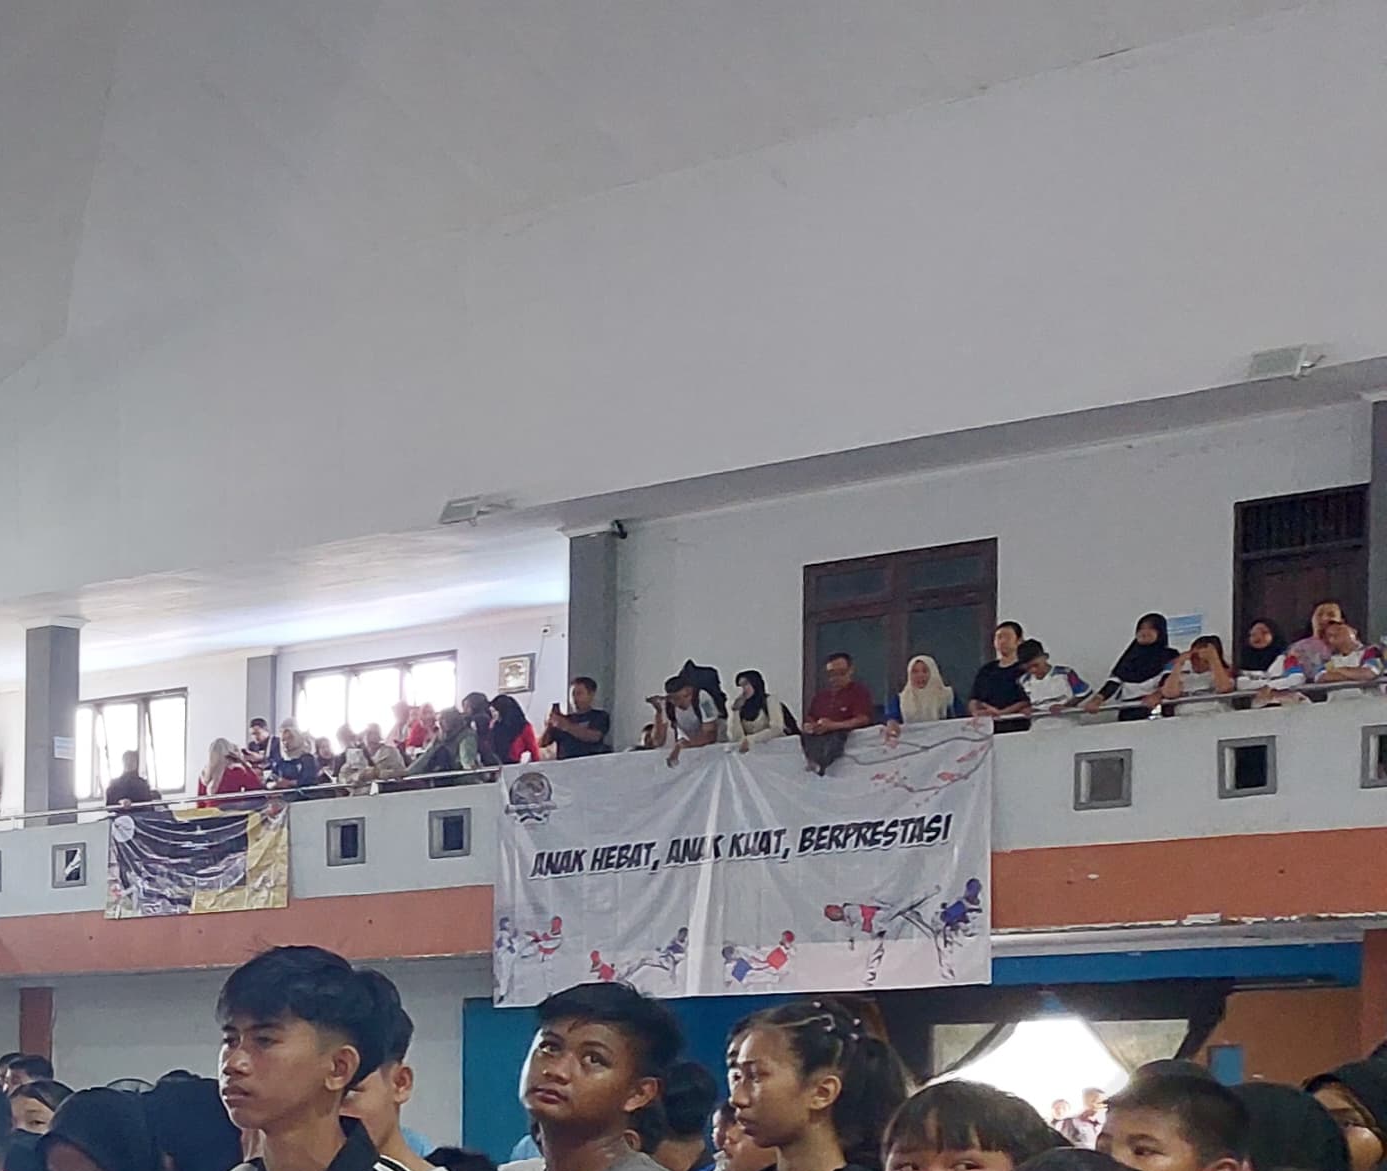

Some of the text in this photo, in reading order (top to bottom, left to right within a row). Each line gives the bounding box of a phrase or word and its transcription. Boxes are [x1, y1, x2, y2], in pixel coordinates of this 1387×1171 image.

[530, 849, 586, 879] ANAK
[589, 841, 660, 874] HEBAT,
[664, 832, 726, 867] ANAK
[797, 813, 953, 854] BERPRESTASI
